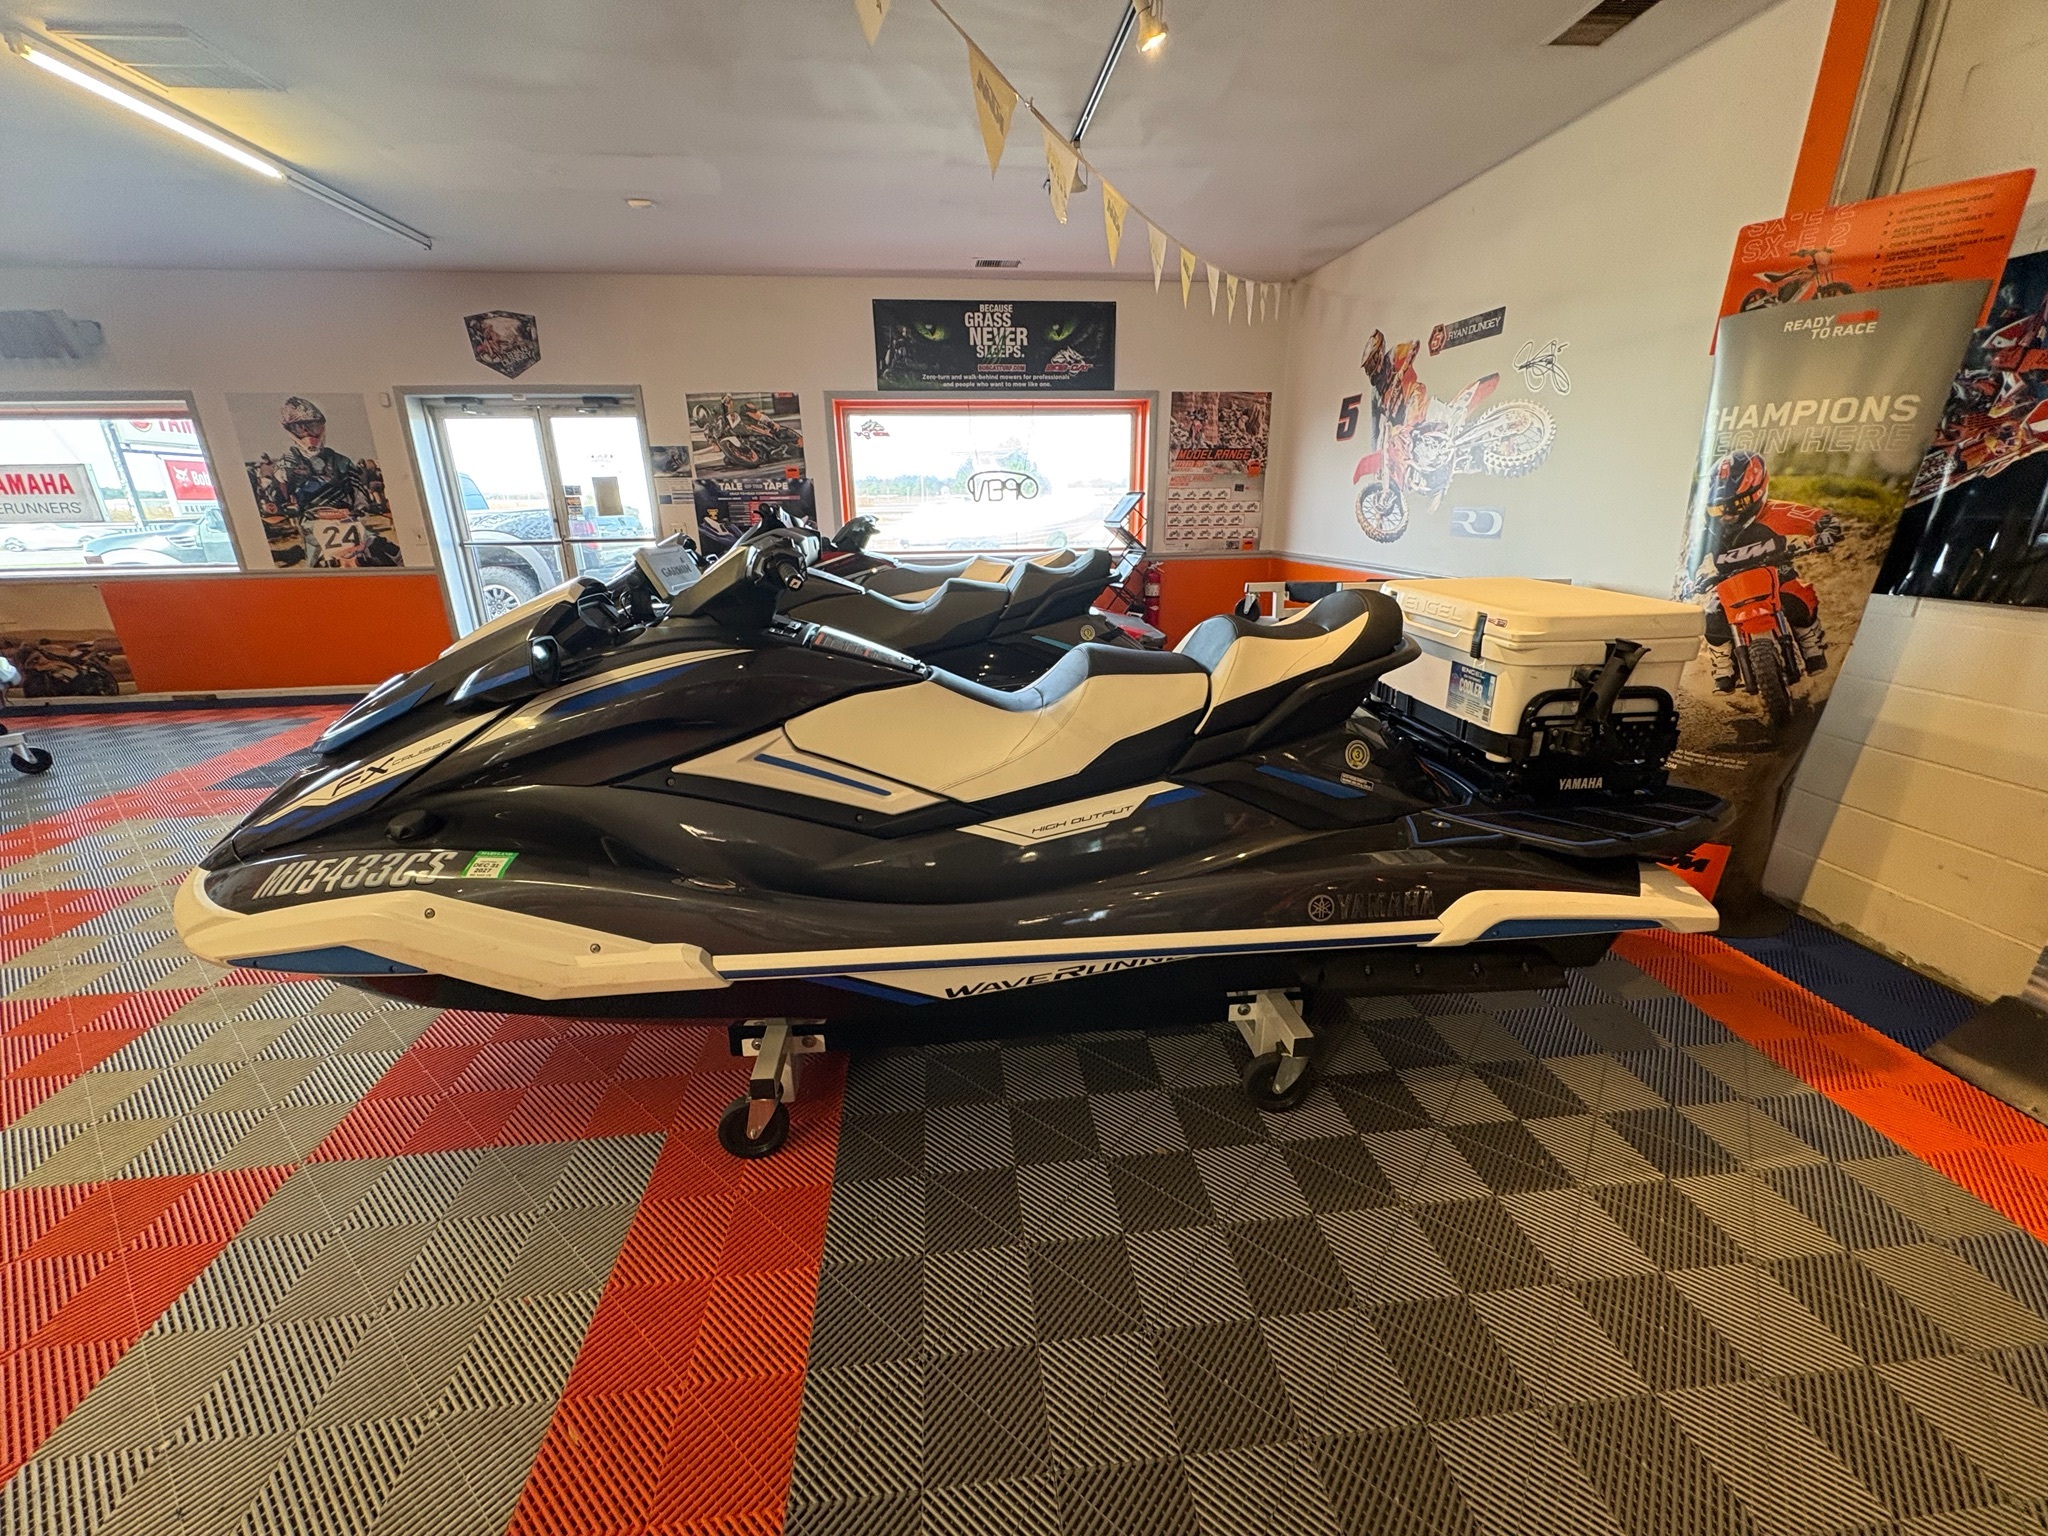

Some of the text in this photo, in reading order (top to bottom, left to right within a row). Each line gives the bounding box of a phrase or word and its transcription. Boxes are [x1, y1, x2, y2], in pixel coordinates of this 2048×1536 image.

[1741, 222, 1851, 263] SX-E 2
[964, 312, 1012, 328] GRASS
[979, 304, 1013, 312] BECAUSE
[969, 327, 1028, 346] NEVER
[1448, 327, 1472, 341] RYAN
[1468, 316, 1502, 335] DUNGEY
[1784, 315, 1835, 333] READY
[1810, 321, 1878, 340] TO RACE
[1336, 393, 1362, 441] 5
[1715, 394, 1921, 431] HAMPIONS
[1801, 423, 1916, 453] HERE
[1213, 449, 1252, 460] RANGE
[718, 482, 743, 491] TALE
[763, 482, 789, 491] TAPE
[323, 525, 360, 550] 24
[1716, 538, 1776, 565] KTM
[1404, 596, 1463, 622] ENGEL
[332, 739, 453, 797] FX CRUISER
[1559, 777, 1603, 791] YAMAHA
[1031, 805, 1134, 834] HIGH OUTPUT
[251, 852, 459, 900] MD5433CS
[1337, 889, 1437, 920] YAMAHA
